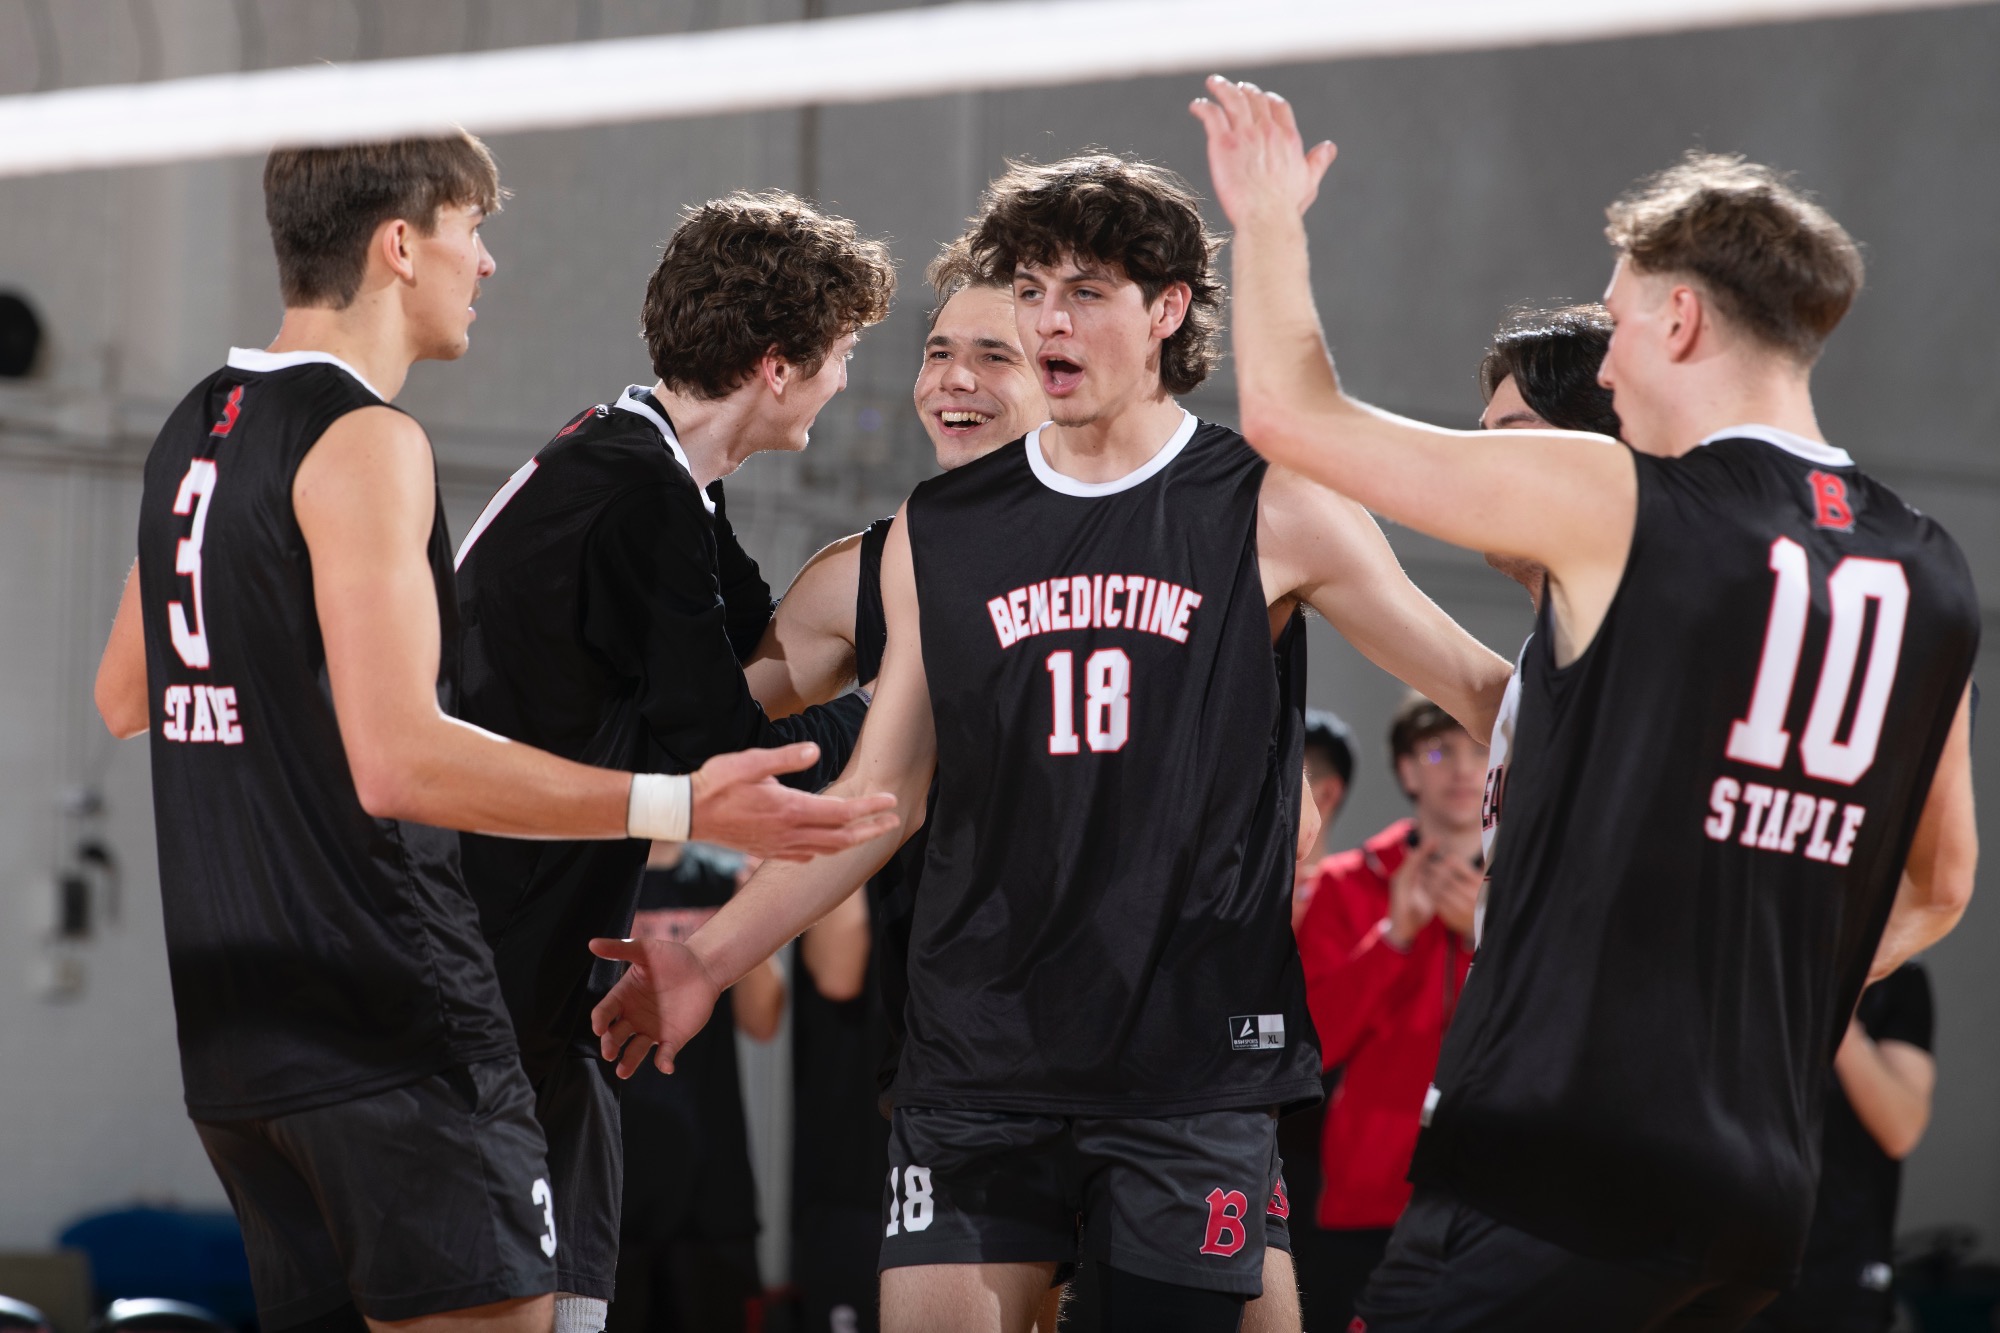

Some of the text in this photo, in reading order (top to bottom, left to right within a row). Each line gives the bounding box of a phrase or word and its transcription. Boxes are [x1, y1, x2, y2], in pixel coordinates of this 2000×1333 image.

[1806, 469, 1855, 533] B
[167, 457, 218, 670] 3
[987, 574, 1203, 649] BENEDICTINE
[1725, 534, 1910, 787] 10
[1046, 647, 1132, 755] 18
[1703, 775, 1867, 867] STAPLE
[1267, 1034, 1279, 1045] XL
[531, 1178, 557, 1258] 3
[886, 1164, 934, 1238] 18
[1199, 1187, 1248, 1257] B
